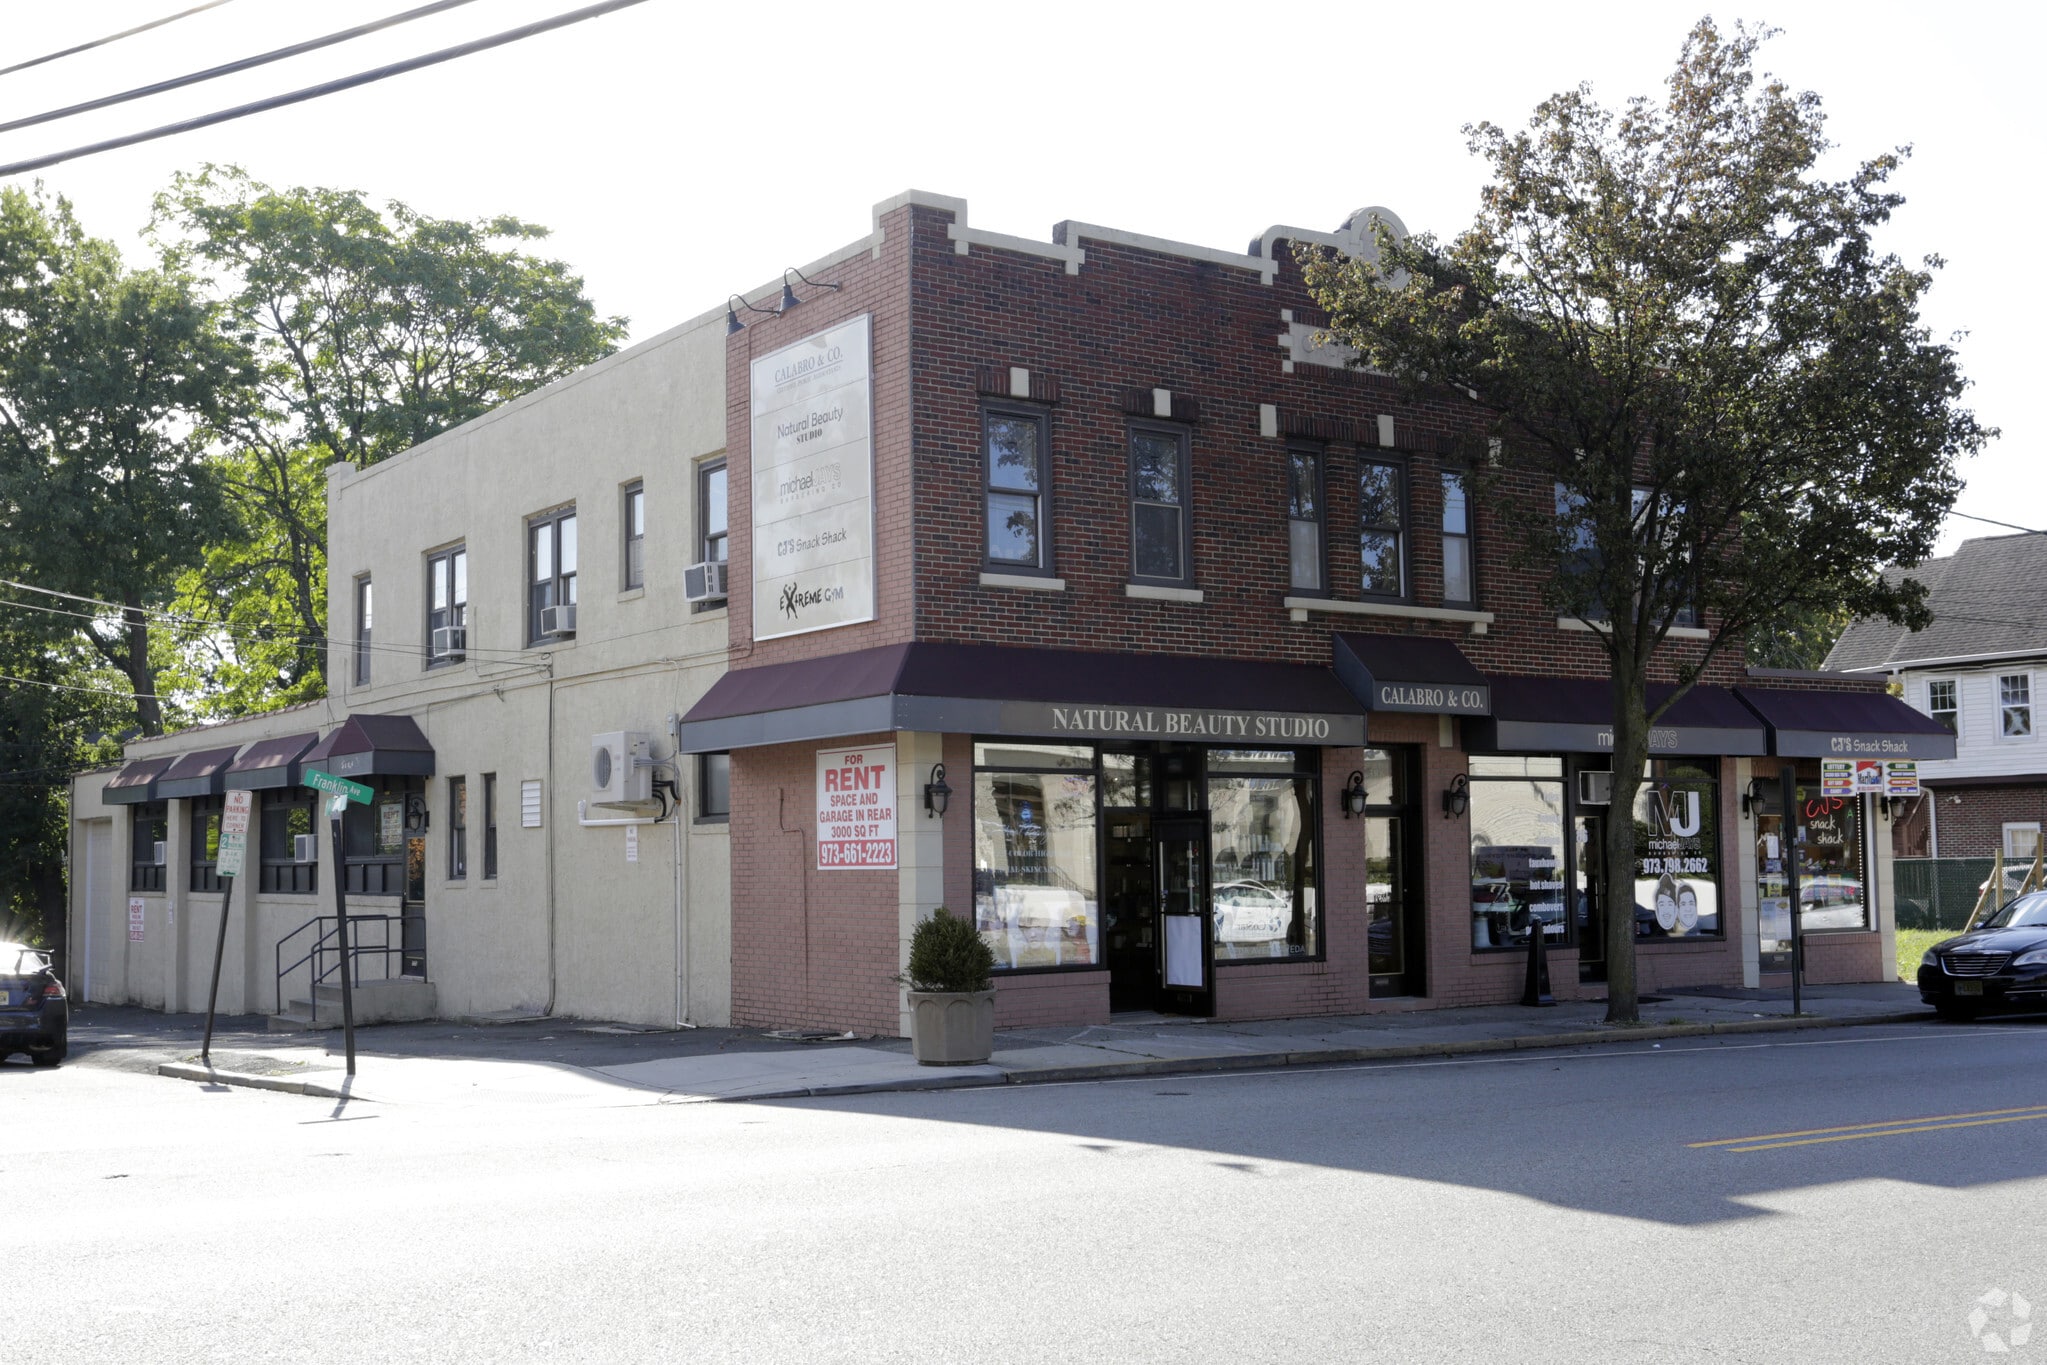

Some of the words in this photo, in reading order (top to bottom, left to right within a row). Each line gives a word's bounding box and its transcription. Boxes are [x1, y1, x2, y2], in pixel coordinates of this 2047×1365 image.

[775, 356, 815, 383] CALABRO
[817, 354, 825, 367] &
[827, 346, 843, 362] CO.
[777, 414, 810, 439] Natural
[811, 406, 844, 427] Beauty
[796, 428, 823, 443] STUDIO
[796, 535, 820, 552] Snack
[821, 527, 847, 546] Shack
[1381, 686, 1444, 707] CALABRO
[1447, 690, 1458, 707] &
[1461, 690, 1483, 708] CO.
[1052, 708, 1159, 733] NATURAL
[1164, 713, 1250, 736] BEAUTY
[1255, 716, 1329, 739] STUDIO
[1853, 739, 1880, 752] Snack
[1881, 740, 1908, 753] Shack
[844, 754, 863, 765] FOR
[312, 774, 349, 794] Franklin
[349, 786, 361, 796] Ave
[825, 765, 885, 792] RENT
[233, 795, 244, 804] NO
[830, 794, 857, 807] SPACE
[859, 793, 878, 806] AND
[225, 805, 249, 814] PARKING
[820, 809, 853, 823] GARAGE
[855, 808, 865, 822] IN
[867, 808, 892, 821] REAR
[1647, 790, 1700, 837] MJ
[831, 825, 852, 838] 3000
[854, 825, 866, 837] SQ
[868, 824, 879, 837] FT
[1810, 814, 1836, 831] snack
[221, 836, 228, 849] 2
[1817, 828, 1844, 845] shack
[821, 842, 892, 864] 973-661-2223
[1643, 857, 1708, 874] 973.798.2662
[1529, 880, 1541, 890] hot
[1529, 902, 1564, 912] combovers
